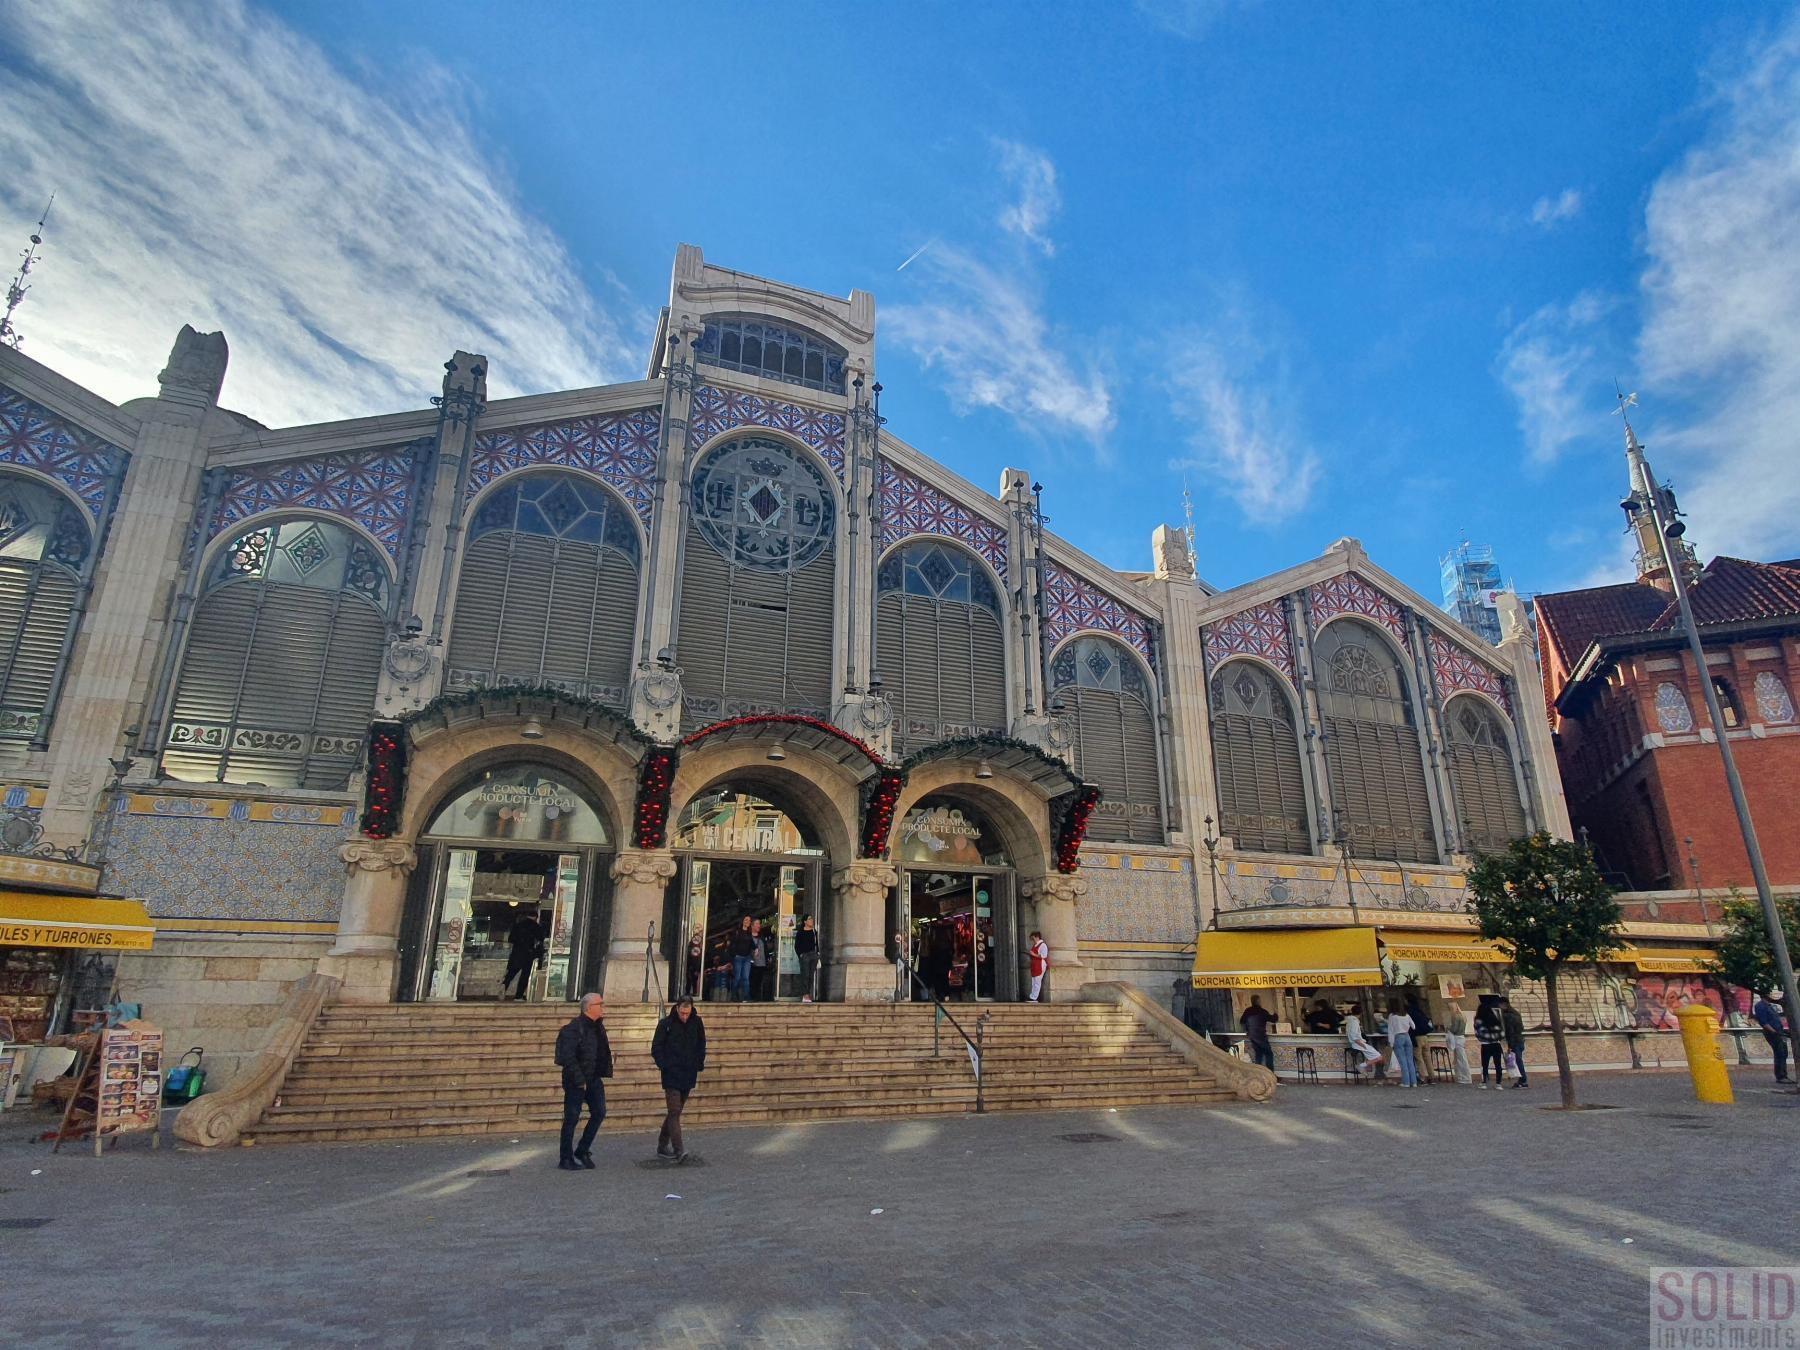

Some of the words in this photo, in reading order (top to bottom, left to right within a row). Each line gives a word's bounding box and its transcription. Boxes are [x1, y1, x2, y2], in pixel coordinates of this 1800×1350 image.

[479, 792, 538, 806] RODUCTE
[902, 822, 951, 834] PRODUCTE
[952, 826, 982, 836] LOCAL
[723, 827, 792, 852] CENTRAL
[0, 927, 29, 942] ILES
[34, 928, 42, 942] Y
[46, 929, 113, 945] TURRONES
[1392, 948, 1427, 959] HORCHATA
[1428, 949, 1457, 959] CHURROS
[1457, 950, 1493, 960] CHOCOLATE
[1194, 976, 1242, 987] HORCHATA
[1243, 975, 1287, 986] CHURROS
[1289, 974, 1347, 985] CHOCOLATE
